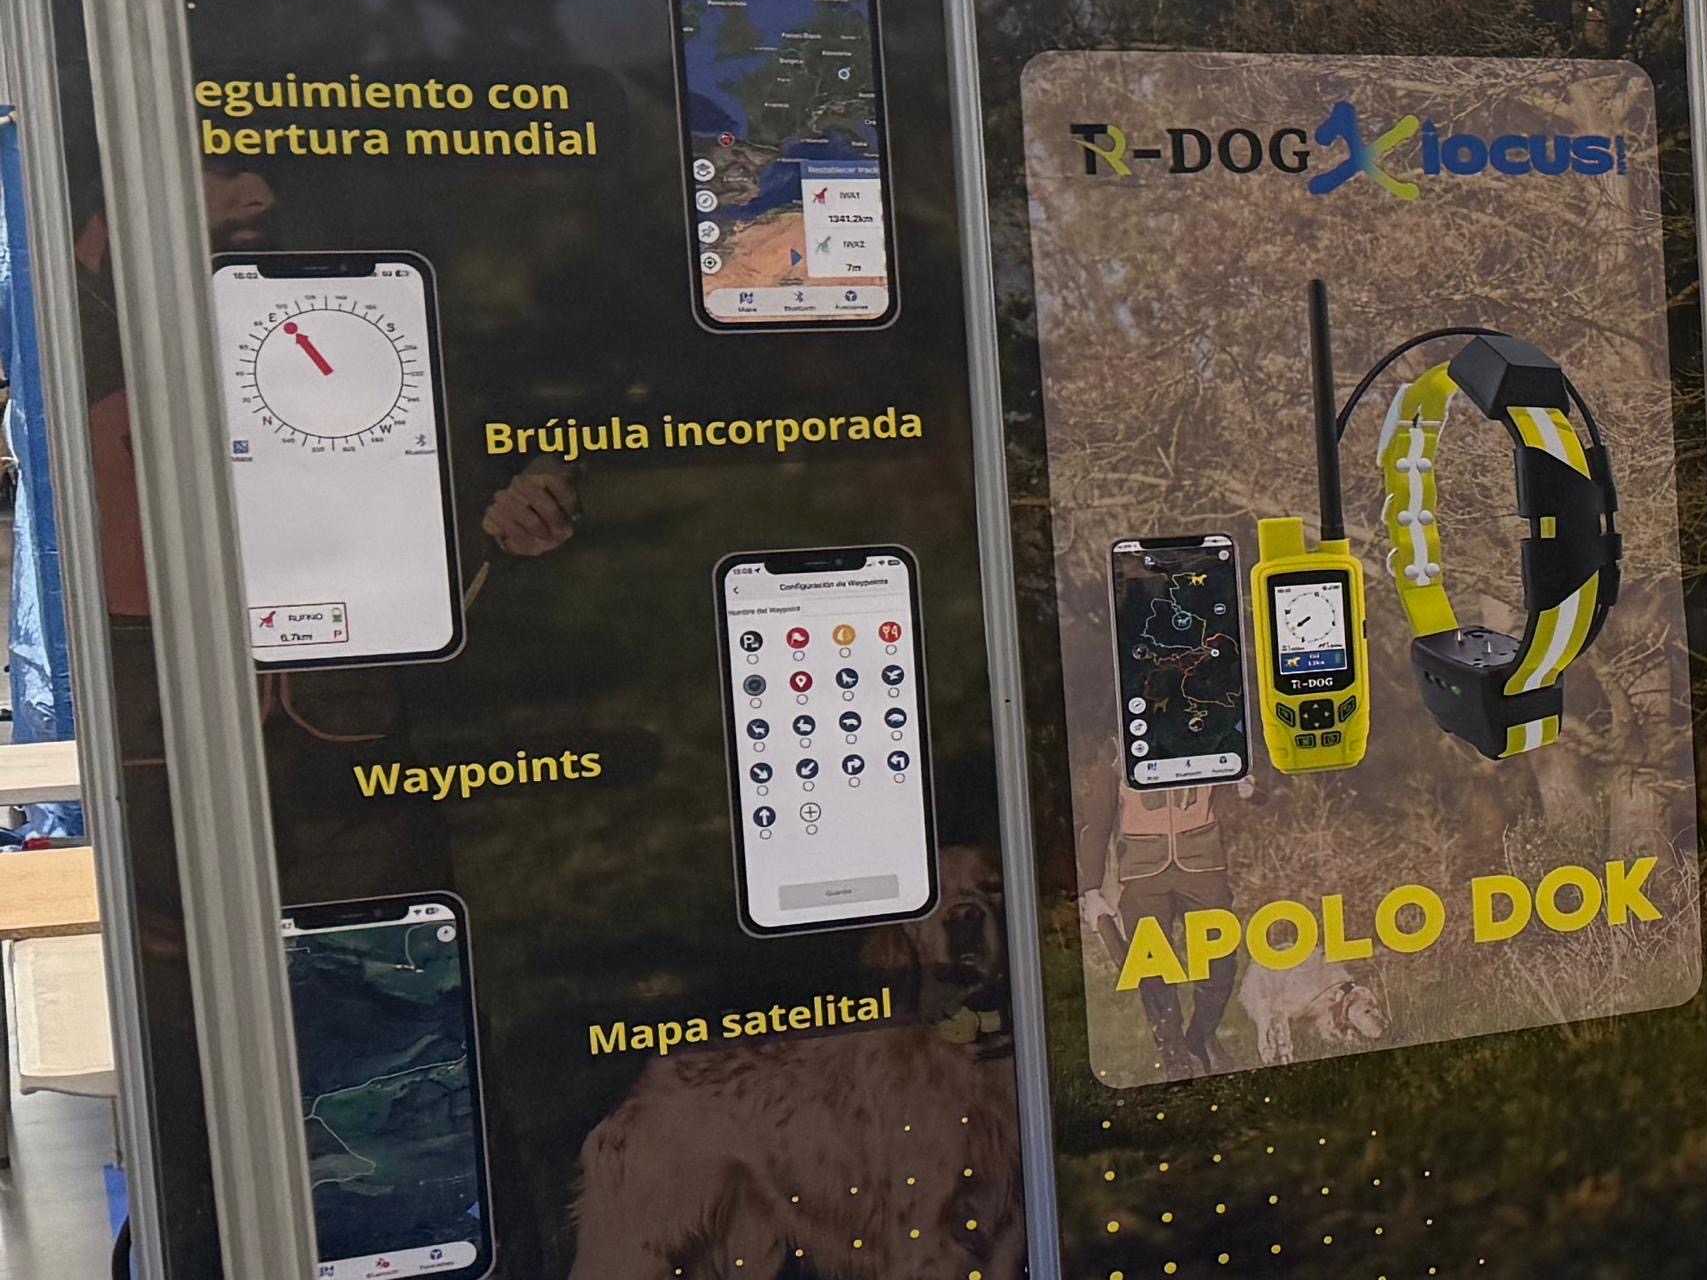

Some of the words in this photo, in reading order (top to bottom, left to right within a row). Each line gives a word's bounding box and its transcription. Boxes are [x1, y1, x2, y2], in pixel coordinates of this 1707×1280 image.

[194, 72, 474, 118] eguimiento
[487, 81, 569, 110] con
[201, 119, 390, 156] bertura
[404, 120, 598, 157] mundial
[484, 414, 651, 462] Brújula
[662, 406, 925, 455] incorporada
[352, 747, 603, 806] Waypoints
[1116, 882, 1446, 991] APOLO
[1471, 855, 1664, 932] DOK
[588, 1018, 709, 1057] Mapa
[721, 987, 894, 1040] satelital
